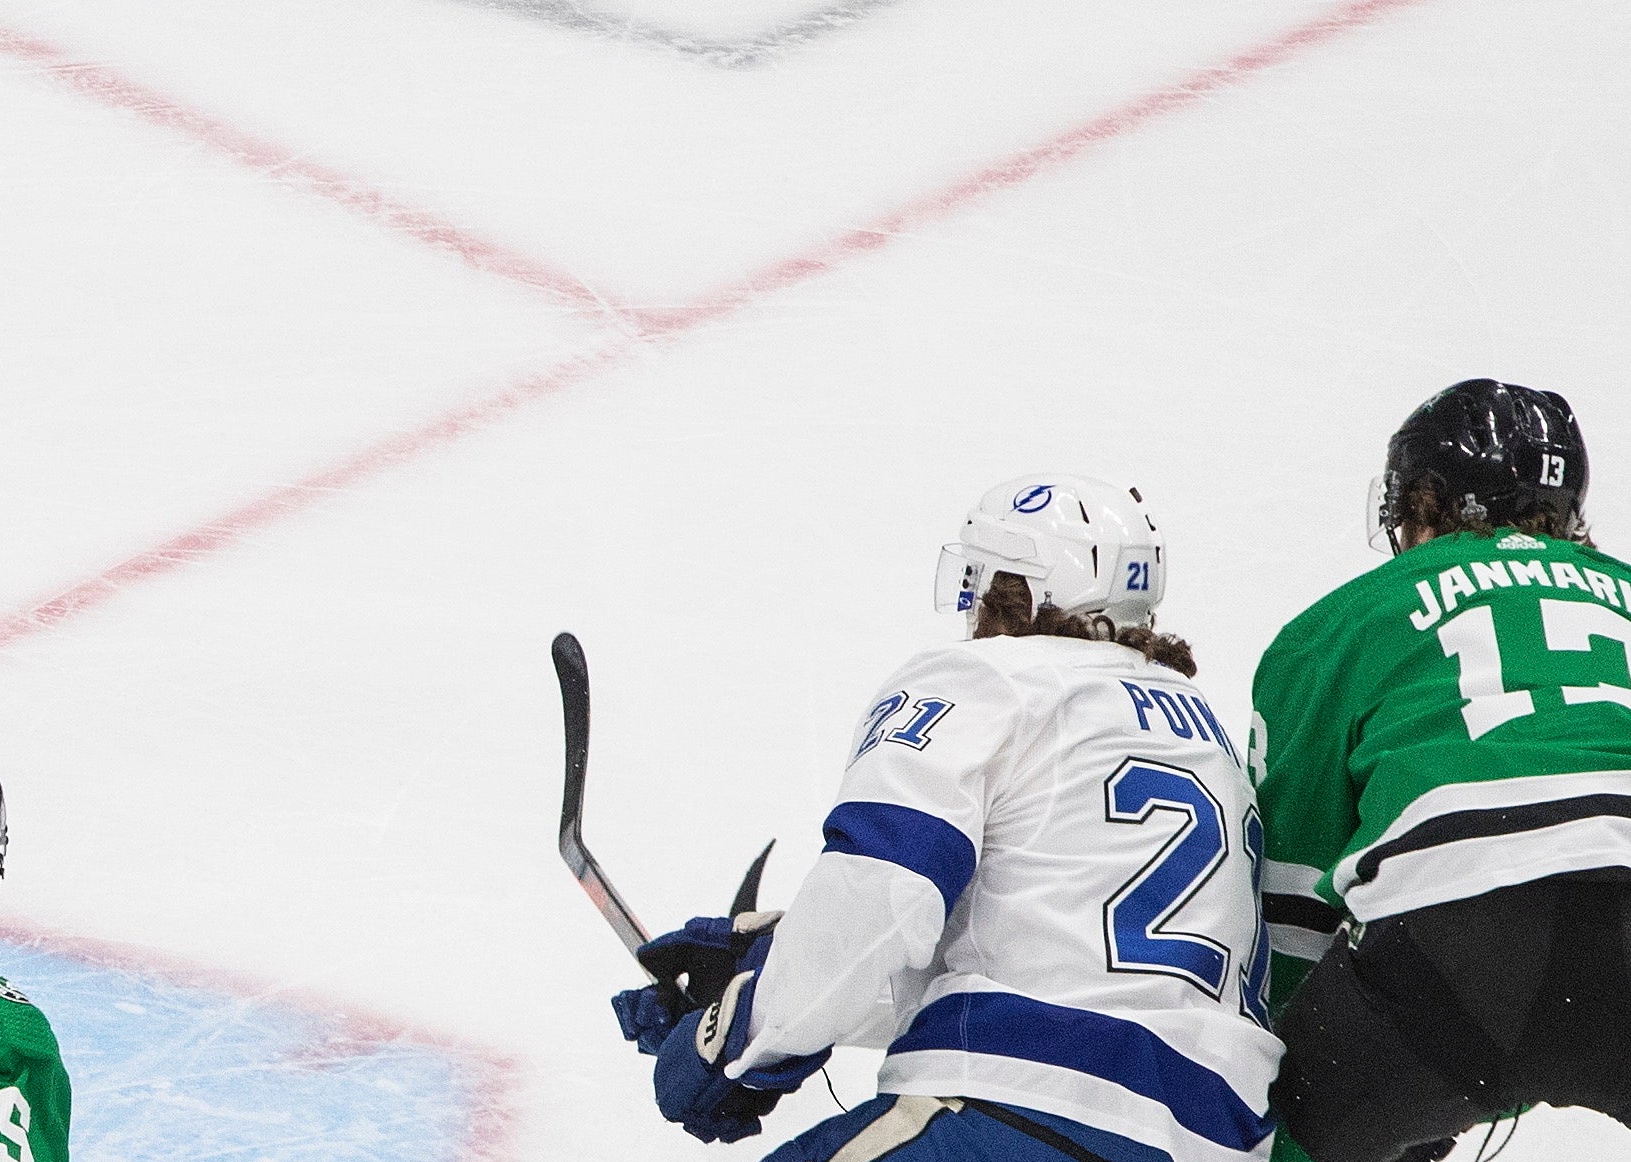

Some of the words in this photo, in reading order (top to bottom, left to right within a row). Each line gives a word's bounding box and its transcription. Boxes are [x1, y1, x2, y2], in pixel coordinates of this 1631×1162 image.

[1539, 453, 1565, 487] 13
[1126, 561, 1149, 591] 21
[845, 690, 956, 772] 21
[1119, 679, 1241, 769] POIN
